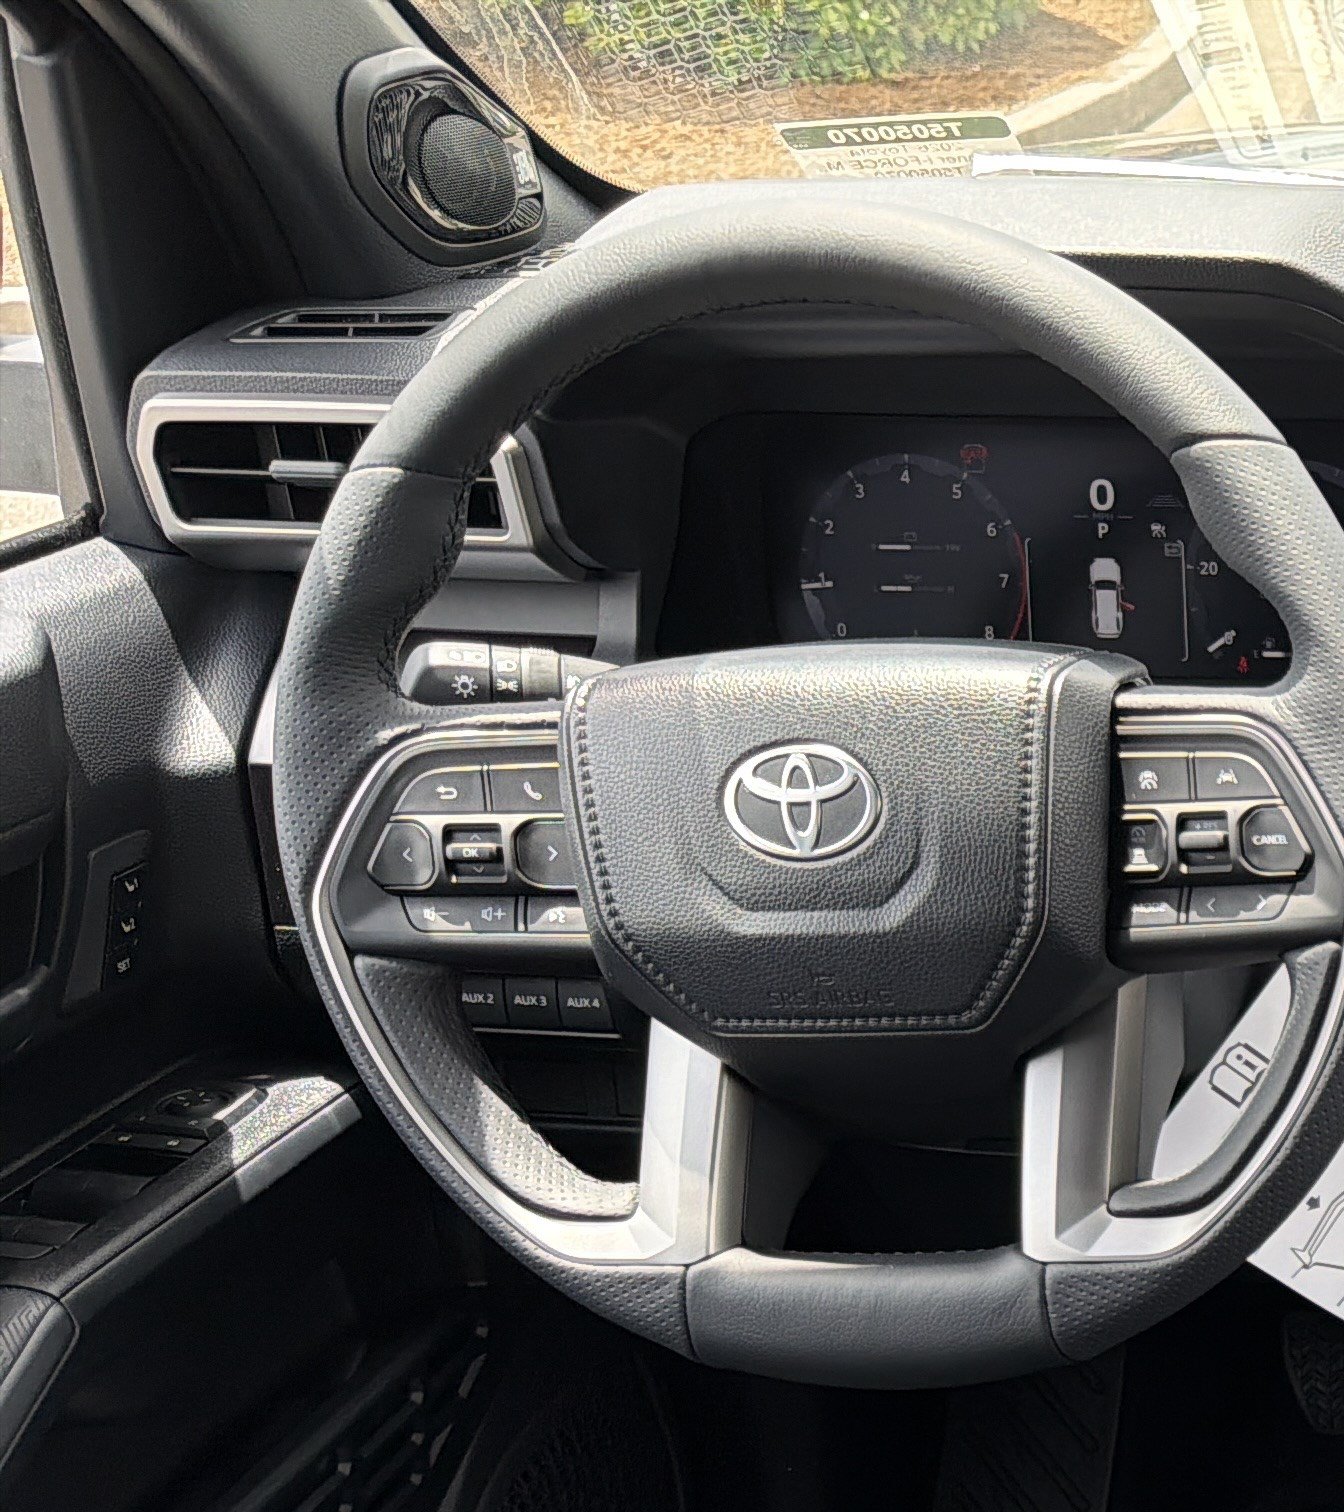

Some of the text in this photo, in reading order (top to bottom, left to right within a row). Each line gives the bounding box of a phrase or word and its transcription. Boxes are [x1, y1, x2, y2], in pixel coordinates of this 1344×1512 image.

[900, 469, 911, 485] 4
[855, 483, 865, 499] 3
[952, 483, 962, 499] 5
[1089, 478, 1115, 512] 0
[823, 519, 835, 535] 2
[986, 522, 997, 538] 6
[1097, 522, 1109, 539] P
[1199, 561, 1219, 576] 20
[999, 573, 1010, 589] 7
[836, 622, 847, 637] 0
[984, 625, 995, 640] 8
[1251, 834, 1288, 846] CANCEL
[462, 847, 480, 858] OK
[116, 958, 131, 973] SET
